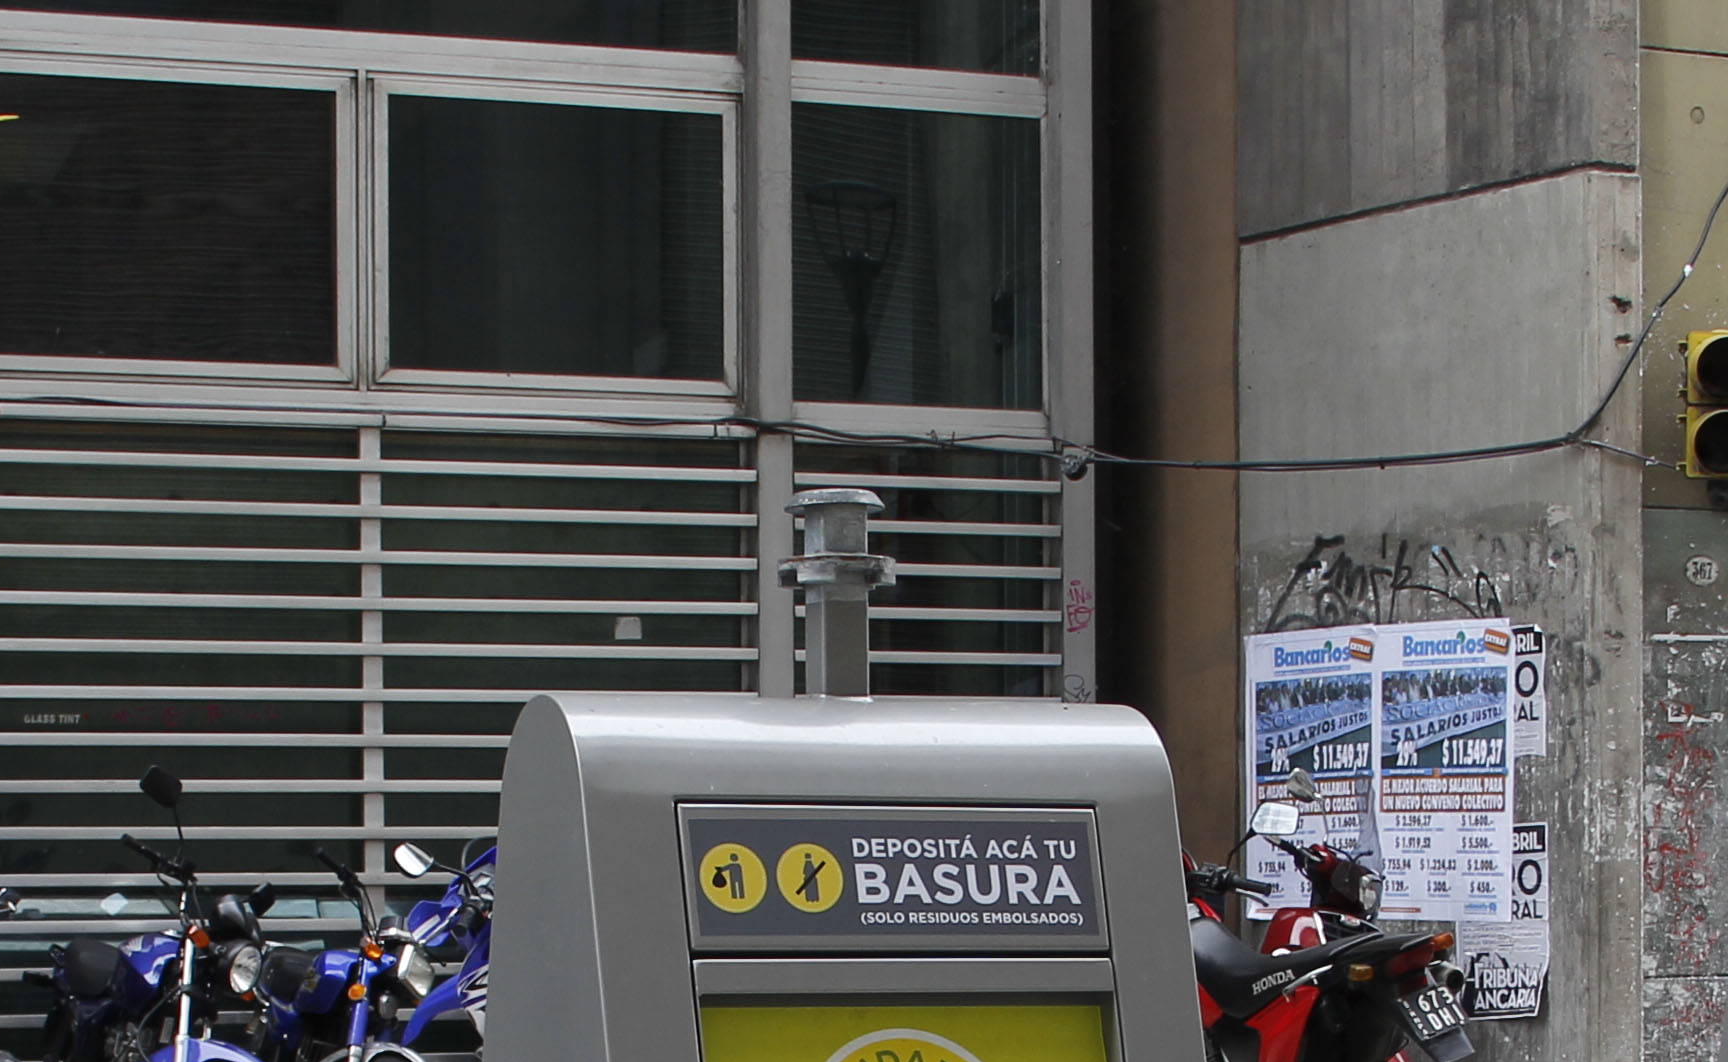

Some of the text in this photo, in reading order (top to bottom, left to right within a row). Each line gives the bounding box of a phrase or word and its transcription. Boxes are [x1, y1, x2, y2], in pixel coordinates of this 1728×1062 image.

[1692, 561, 1712, 580] 367
[1274, 641, 1351, 668] Bancarios
[1403, 632, 1486, 657] Bancarios
[58, 714, 80, 724] TINT
[1514, 701, 1539, 722] AL
[1265, 719, 1336, 754] SALARIOS
[1391, 712, 1467, 745] SALARIOS
[1452, 739, 1503, 768] 11.549,37
[1383, 777, 1503, 793] EL MEJOR ACUERDO SALARIAL PARA
[1383, 794, 1503, 810] UN NUEVO CONVENIO COLECTIVO
[852, 835, 1076, 860] DEPOSITÁ ACÁ TU
[854, 863, 1082, 906] BASURA
[861, 912, 1084, 926] (SOLO RESIDUOS EMBOLSADOS)
[1252, 968, 1295, 995] HONDA
[1418, 986, 1454, 1012] 673
